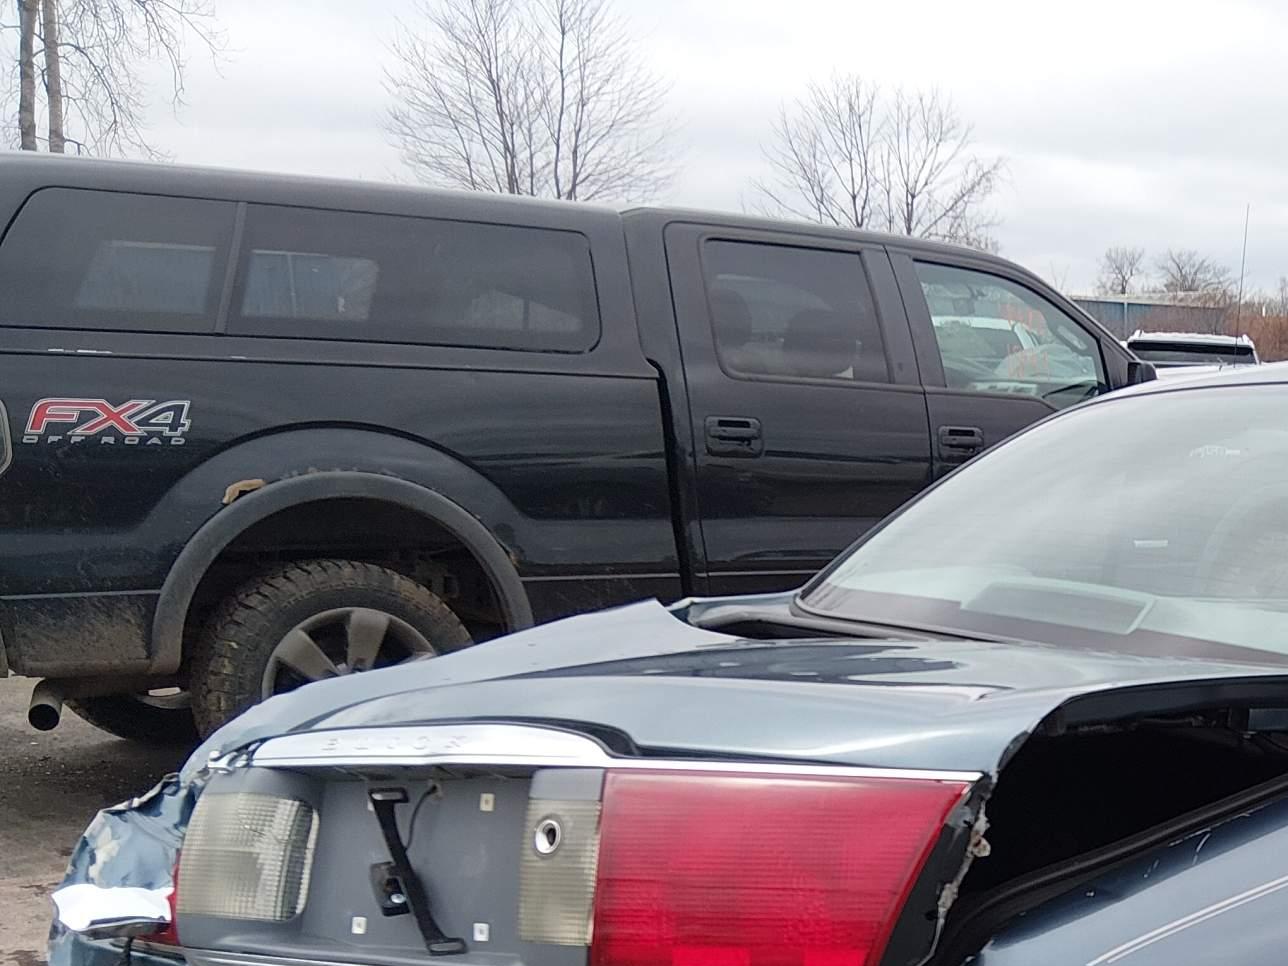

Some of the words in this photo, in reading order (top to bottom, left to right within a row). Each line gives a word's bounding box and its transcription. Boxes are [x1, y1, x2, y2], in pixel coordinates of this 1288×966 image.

[24, 398, 192, 437] FX4
[22, 435, 86, 445] OFF
[100, 436, 186, 446] ROAD
